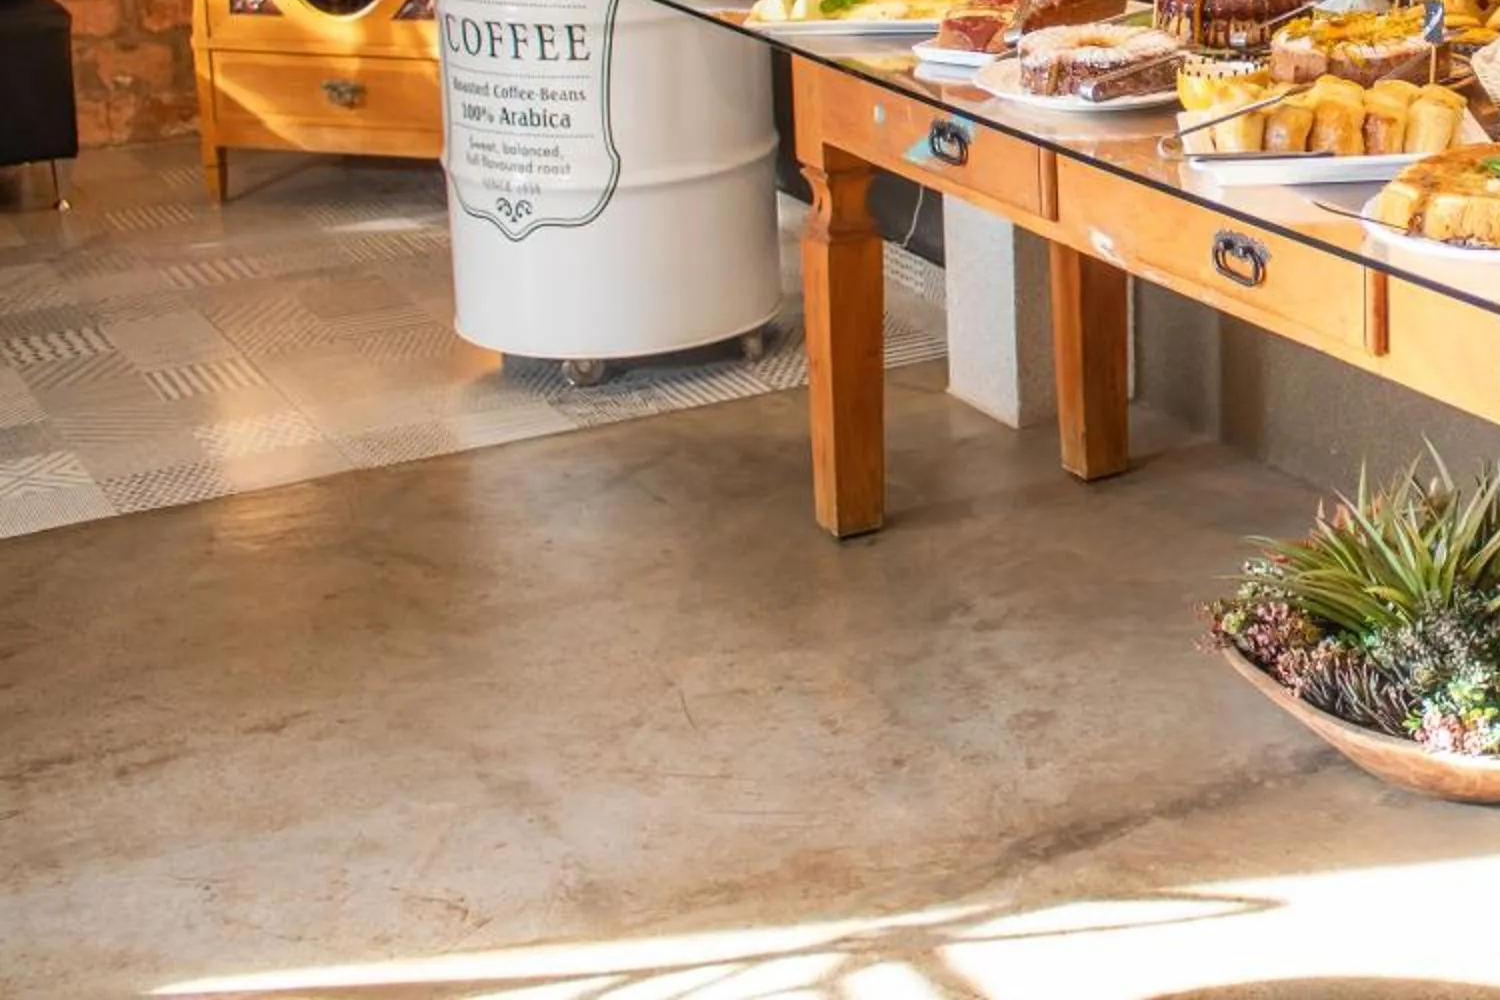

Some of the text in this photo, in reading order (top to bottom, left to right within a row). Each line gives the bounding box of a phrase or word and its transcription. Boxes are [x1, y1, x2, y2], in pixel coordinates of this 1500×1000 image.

[445, 12, 591, 62] COFFEE
[453, 77, 586, 102] Roasted Coffee Beans
[461, 102, 571, 129] 100% Arabica
[537, 163, 571, 175] roast
